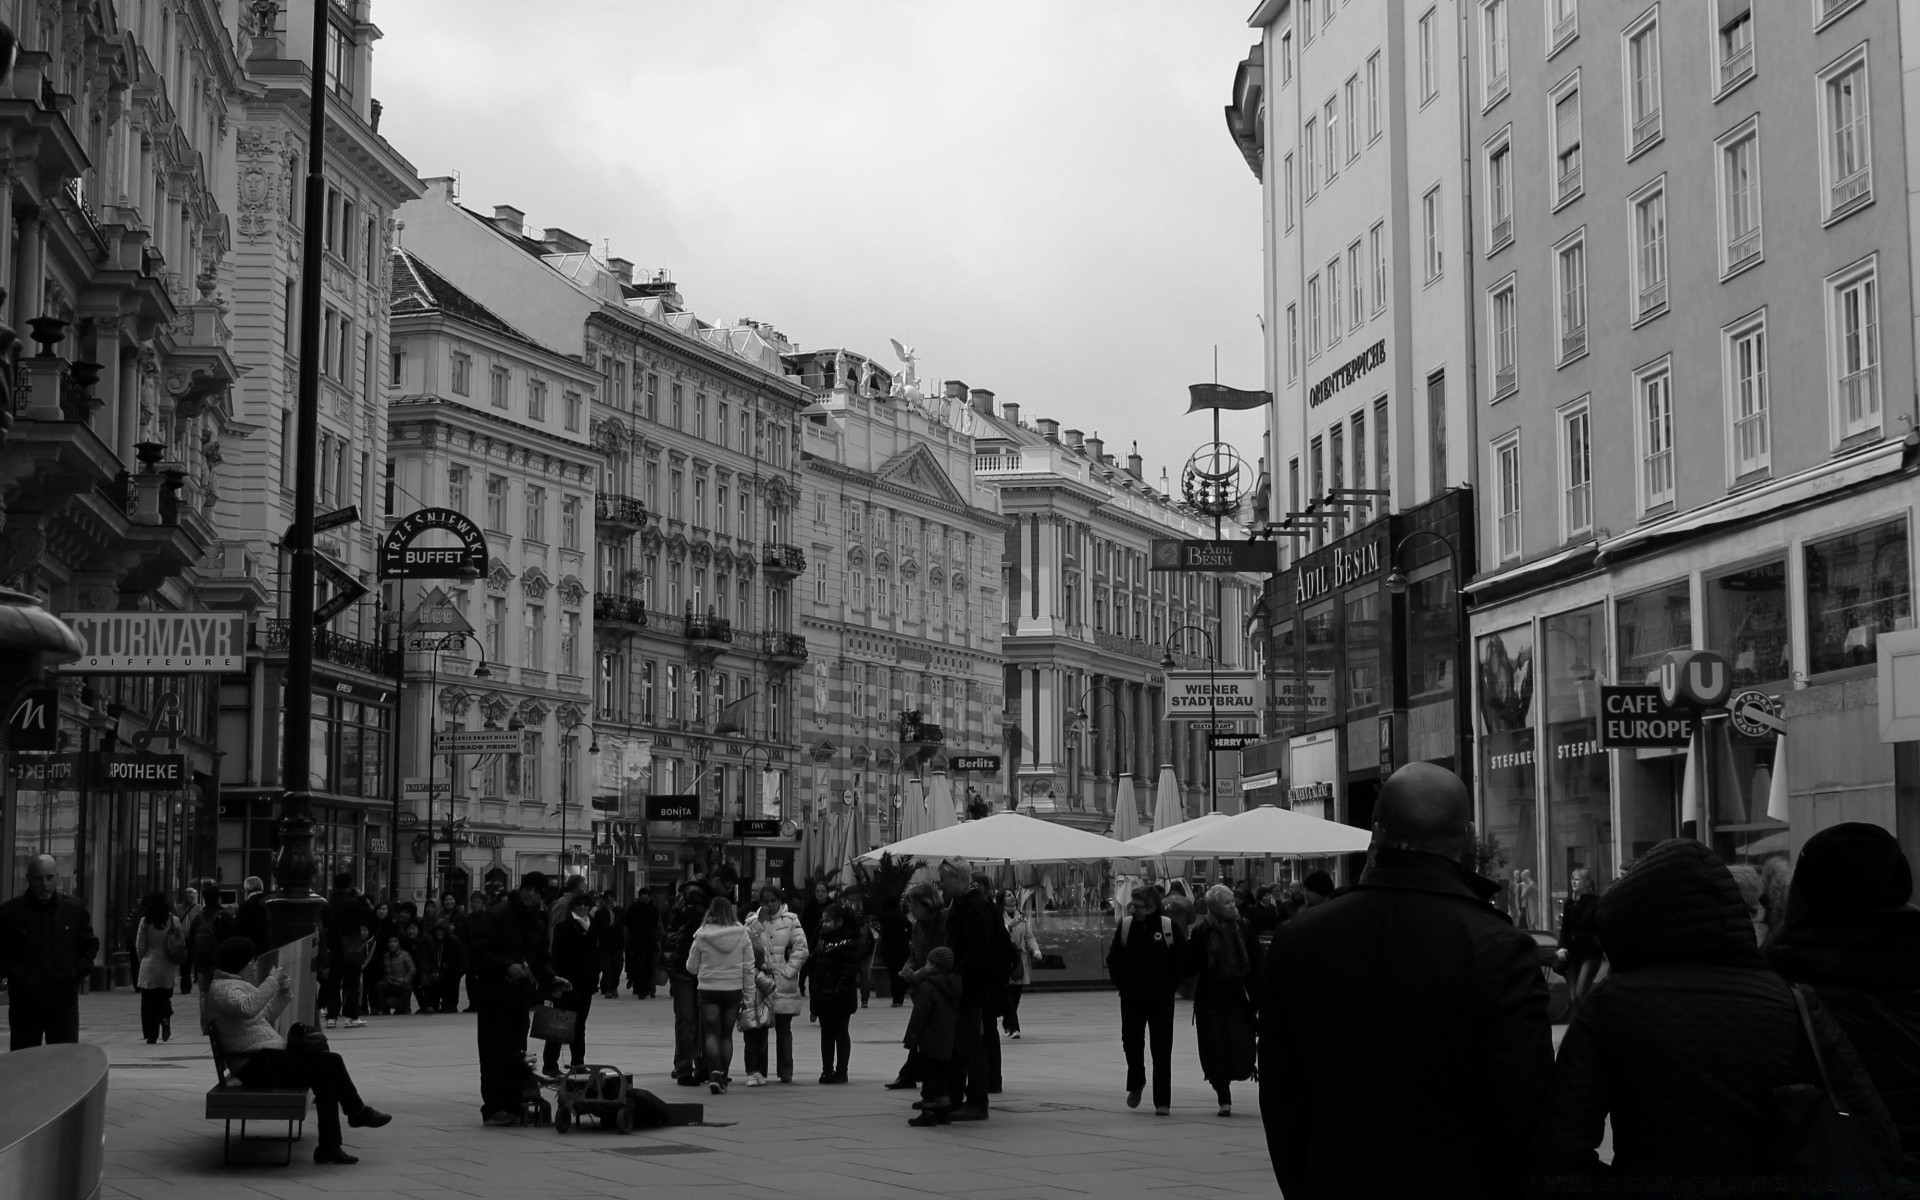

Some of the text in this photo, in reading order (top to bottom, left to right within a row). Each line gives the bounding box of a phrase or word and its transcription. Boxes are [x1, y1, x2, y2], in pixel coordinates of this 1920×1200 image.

[1186, 546, 1233, 566] BESIM
[1202, 541, 1233, 554] ADIL
[405, 551, 463, 564] BUFFET
[1295, 541, 1381, 604] ADIL BESIM
[72, 618, 232, 656] STURMAYR
[1689, 661, 1724, 699] U
[1185, 684, 1239, 694] WIENER
[1171, 696, 1253, 707] STADTBRÄU
[1606, 694, 1657, 714] CAFE
[1740, 694, 1772, 711] TABAK
[1608, 720, 1692, 739] EUROPE
[1735, 711, 1765, 734] TRAFIK
[109, 762, 178, 779] APOTHEKE
[958, 758, 995, 769] Berlitz
[751, 822, 766, 830] IWC
